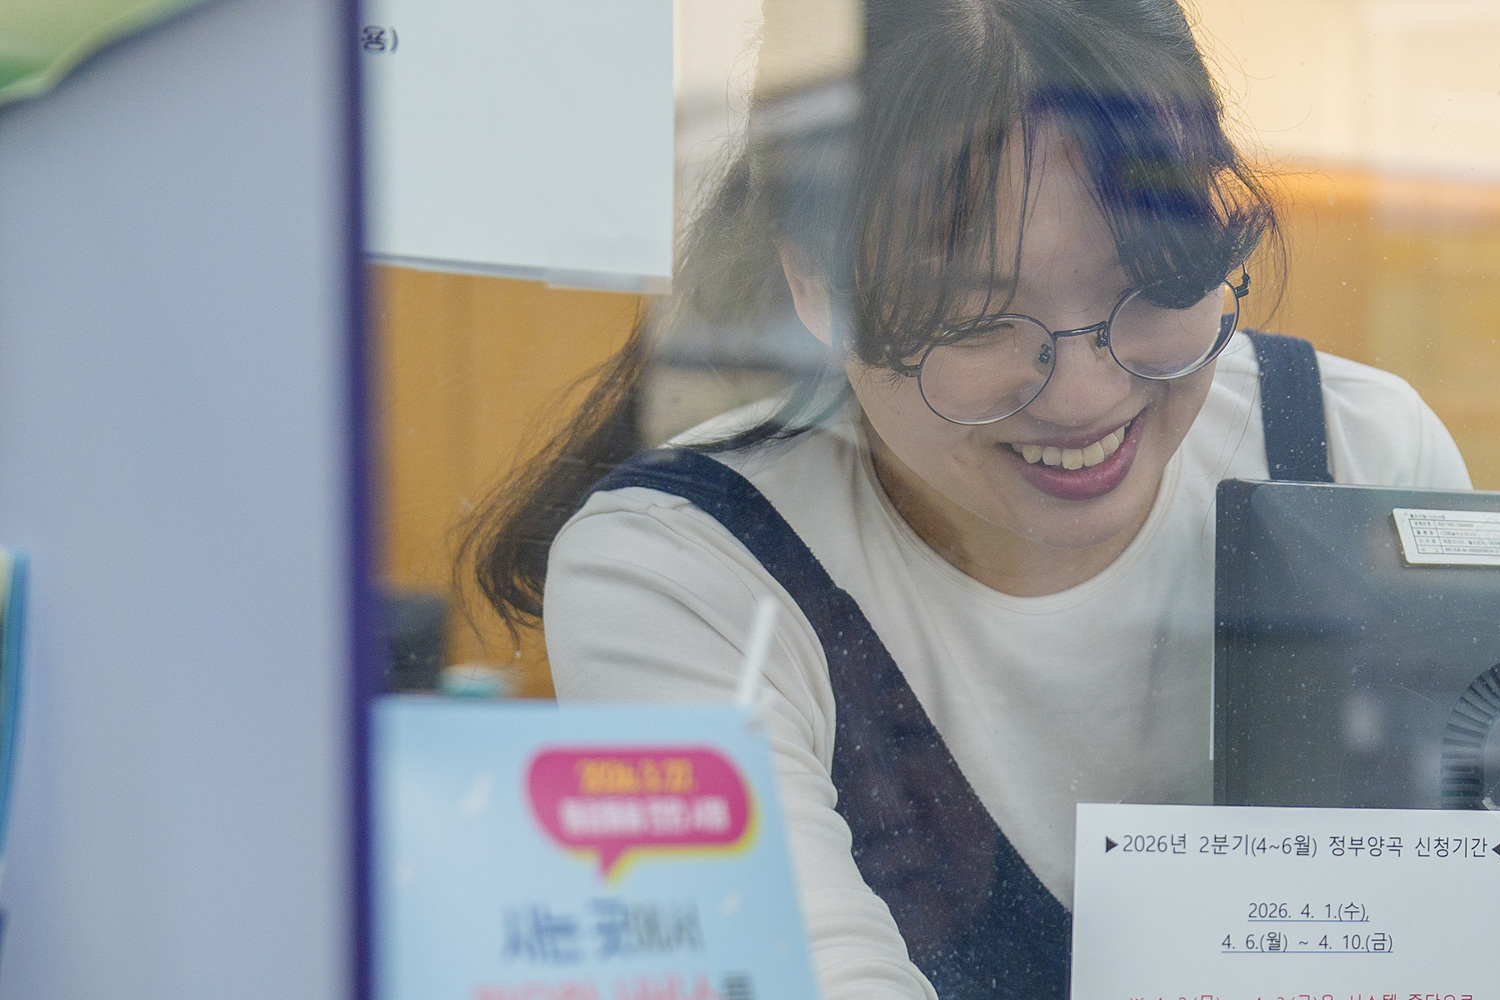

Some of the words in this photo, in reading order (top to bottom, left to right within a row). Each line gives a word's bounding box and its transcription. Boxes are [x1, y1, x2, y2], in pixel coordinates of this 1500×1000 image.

[1122, 833, 1188, 855] 2026년
[1199, 834, 1318, 858] 2분기(4~6월)
[1328, 835, 1404, 858] 정부양곡
[1414, 836, 1489, 859] 신청기간
[1248, 902, 1292, 919] 2026.
[1300, 903, 1314, 919] 4.
[1321, 901, 1371, 923] 1.(수),
[1221, 934, 1236, 951] 4.
[1244, 931, 1289, 953] 6.(월)
[1318, 934, 1332, 951] 4.
[1342, 932, 1394, 953] 10.(금)
